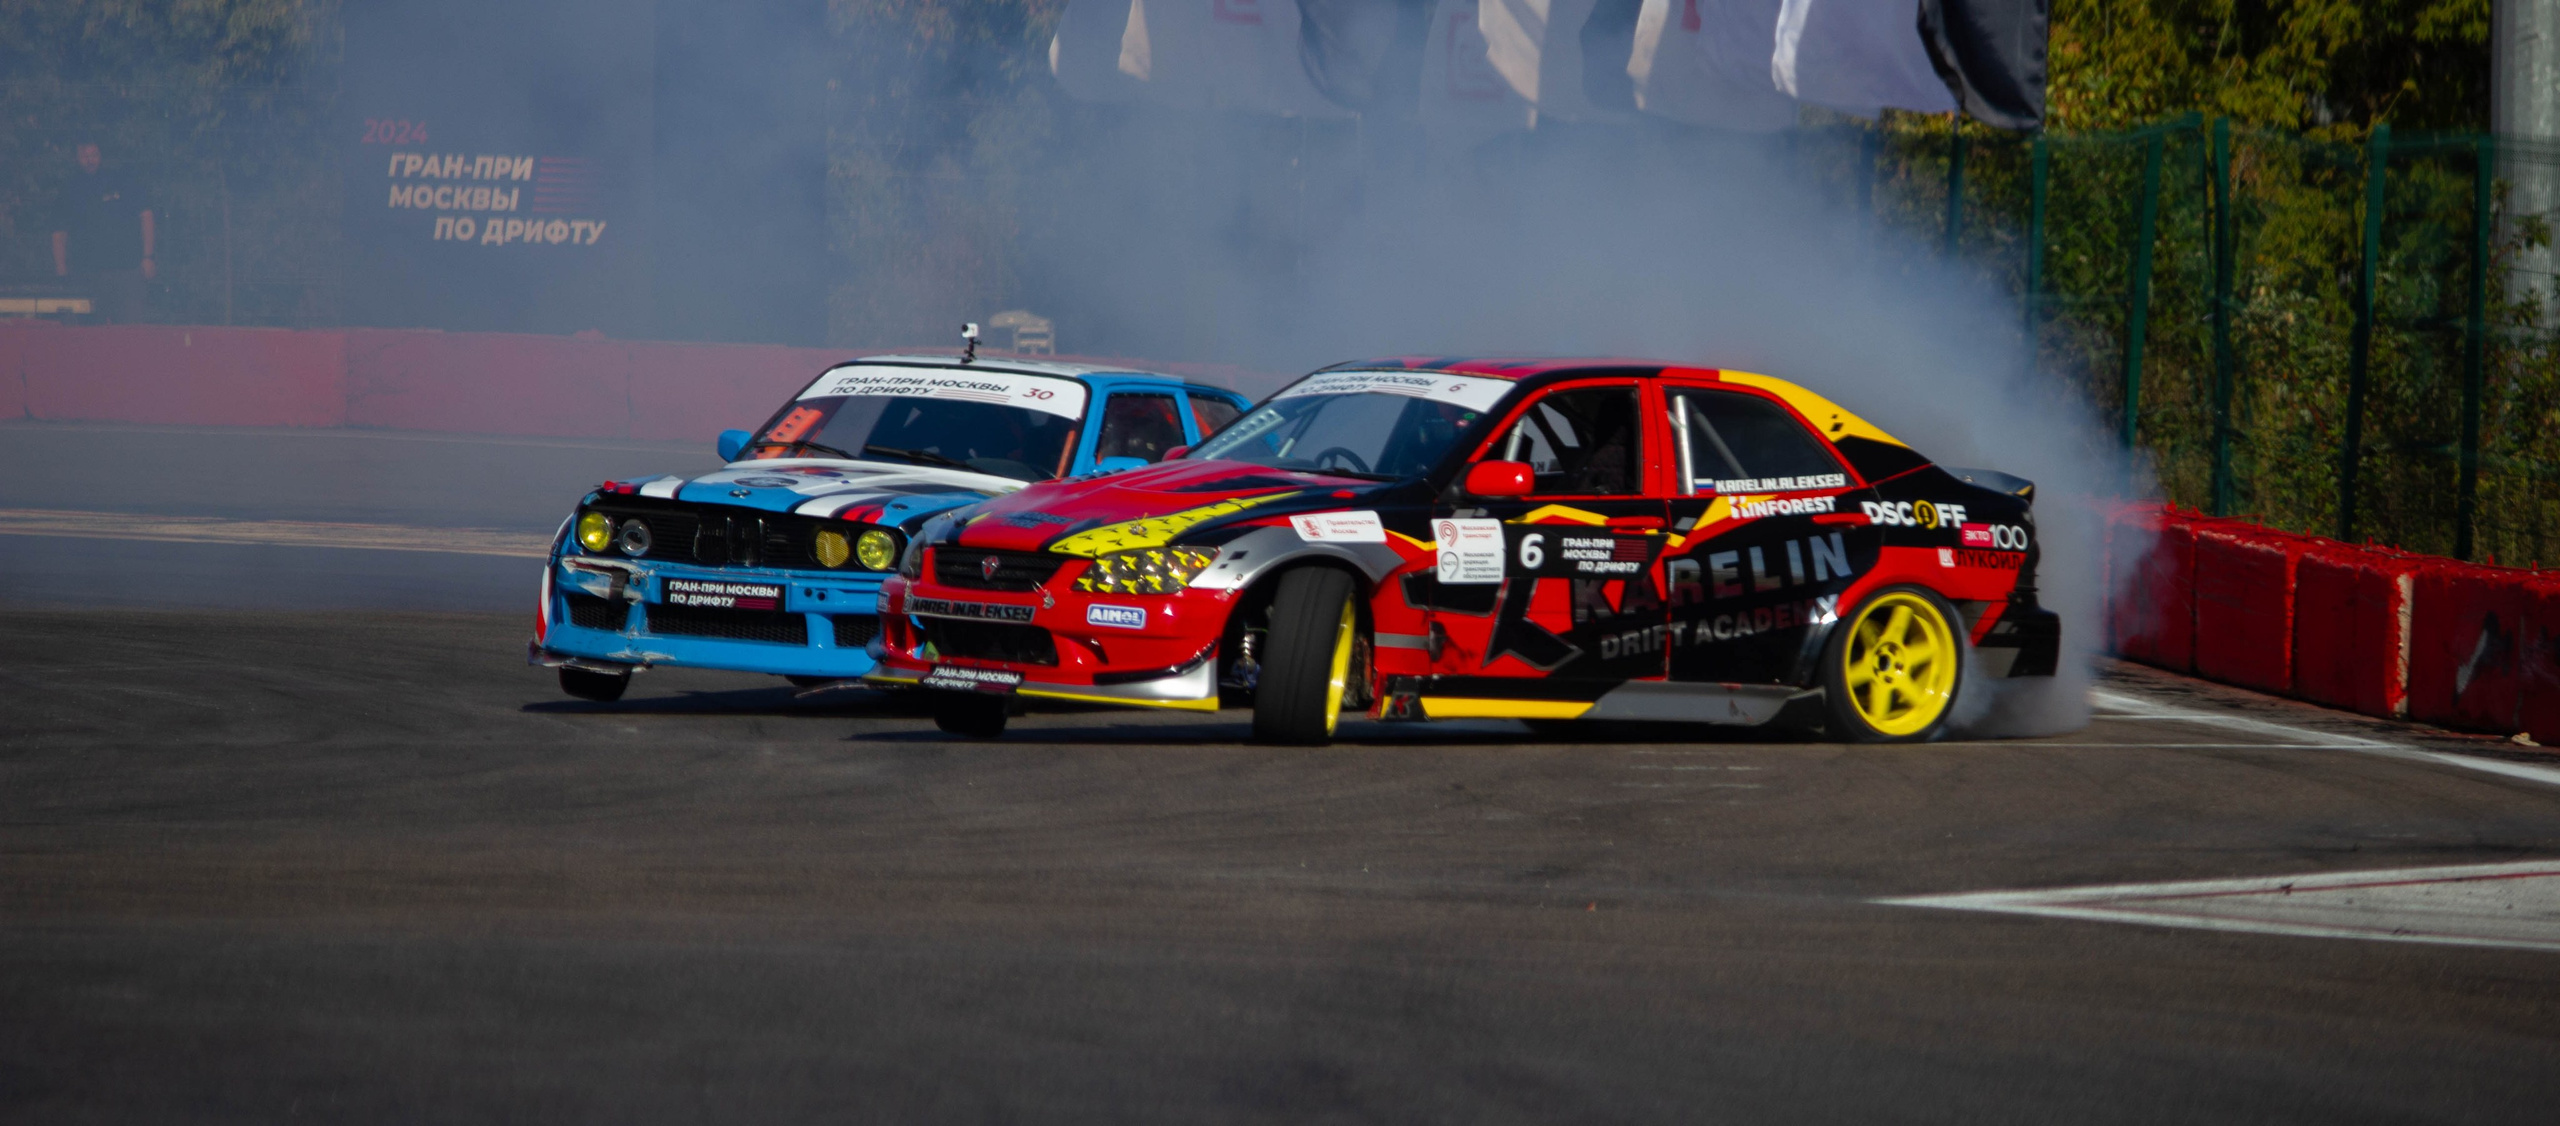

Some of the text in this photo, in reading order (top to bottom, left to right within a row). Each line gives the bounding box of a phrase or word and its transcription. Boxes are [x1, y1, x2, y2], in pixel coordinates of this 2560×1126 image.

[361, 118, 428, 144] 2024
[388, 153, 533, 181] ГРАН-ПРИ
[388, 184, 520, 211] МОСКВЫ
[434, 216, 606, 246] ПО ДРИФТУ
[830, 386, 935, 396] ПО ДРИФТУ
[836, 376, 1011, 392] ГРАН-ПРИ МОСКВЫ
[1449, 382, 1468, 393] 6
[1022, 387, 1055, 401] 30
[1562, 538, 1615, 549] ГРАН-ПРИ
[1965, 524, 2028, 550] ЭКТО 100
[1520, 533, 1544, 569] 6
[1562, 549, 1611, 560] МОСКВЫ
[1578, 561, 1640, 573] ПО ДРИФТУ
[669, 580, 780, 598] ГРАН-ПРИ МОСКВЫ
[669, 593, 735, 607] ПО ДРИФТУ
[1601, 621, 1687, 660] DRIFT
[933, 667, 1021, 684] ГРАН-ПРИ МОСКВЫ
